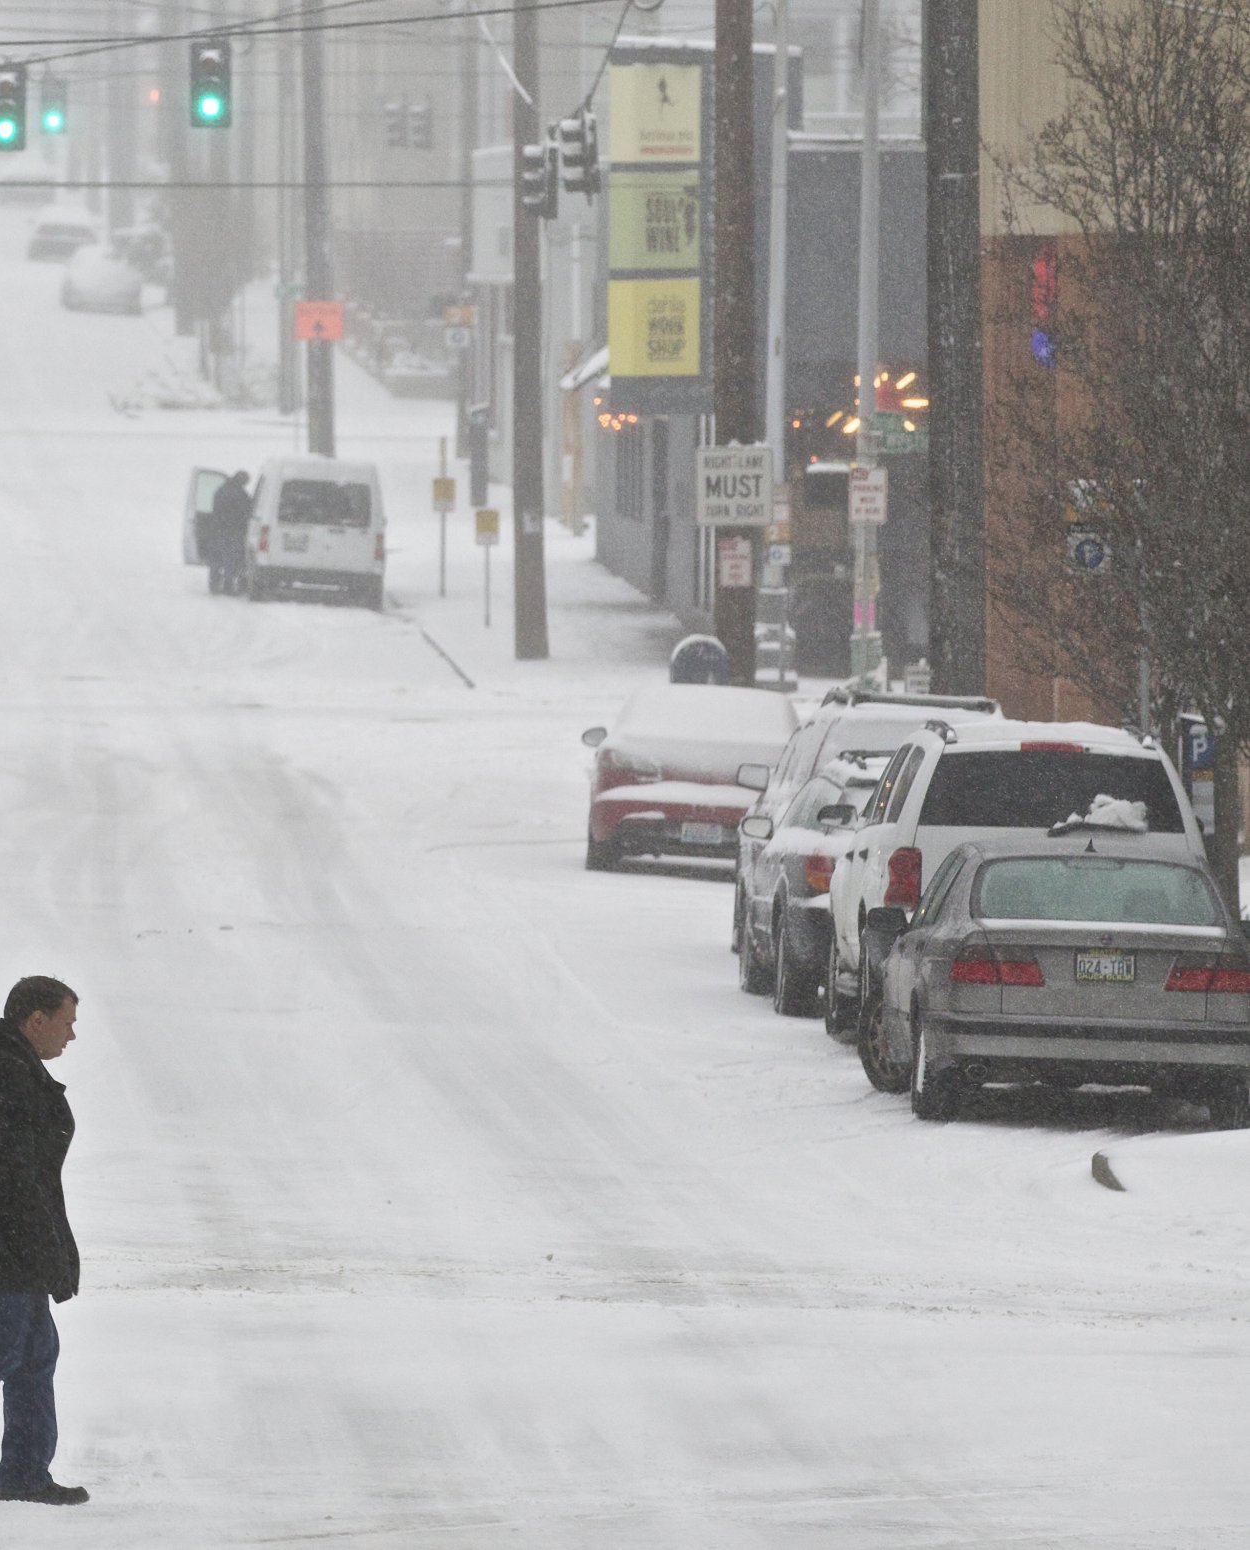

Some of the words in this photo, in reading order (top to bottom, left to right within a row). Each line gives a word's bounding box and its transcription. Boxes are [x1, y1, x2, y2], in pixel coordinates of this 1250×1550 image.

[705, 474, 764, 499] MUST
[705, 503, 730, 517] TURN
[736, 503, 764, 517] RIGHT
